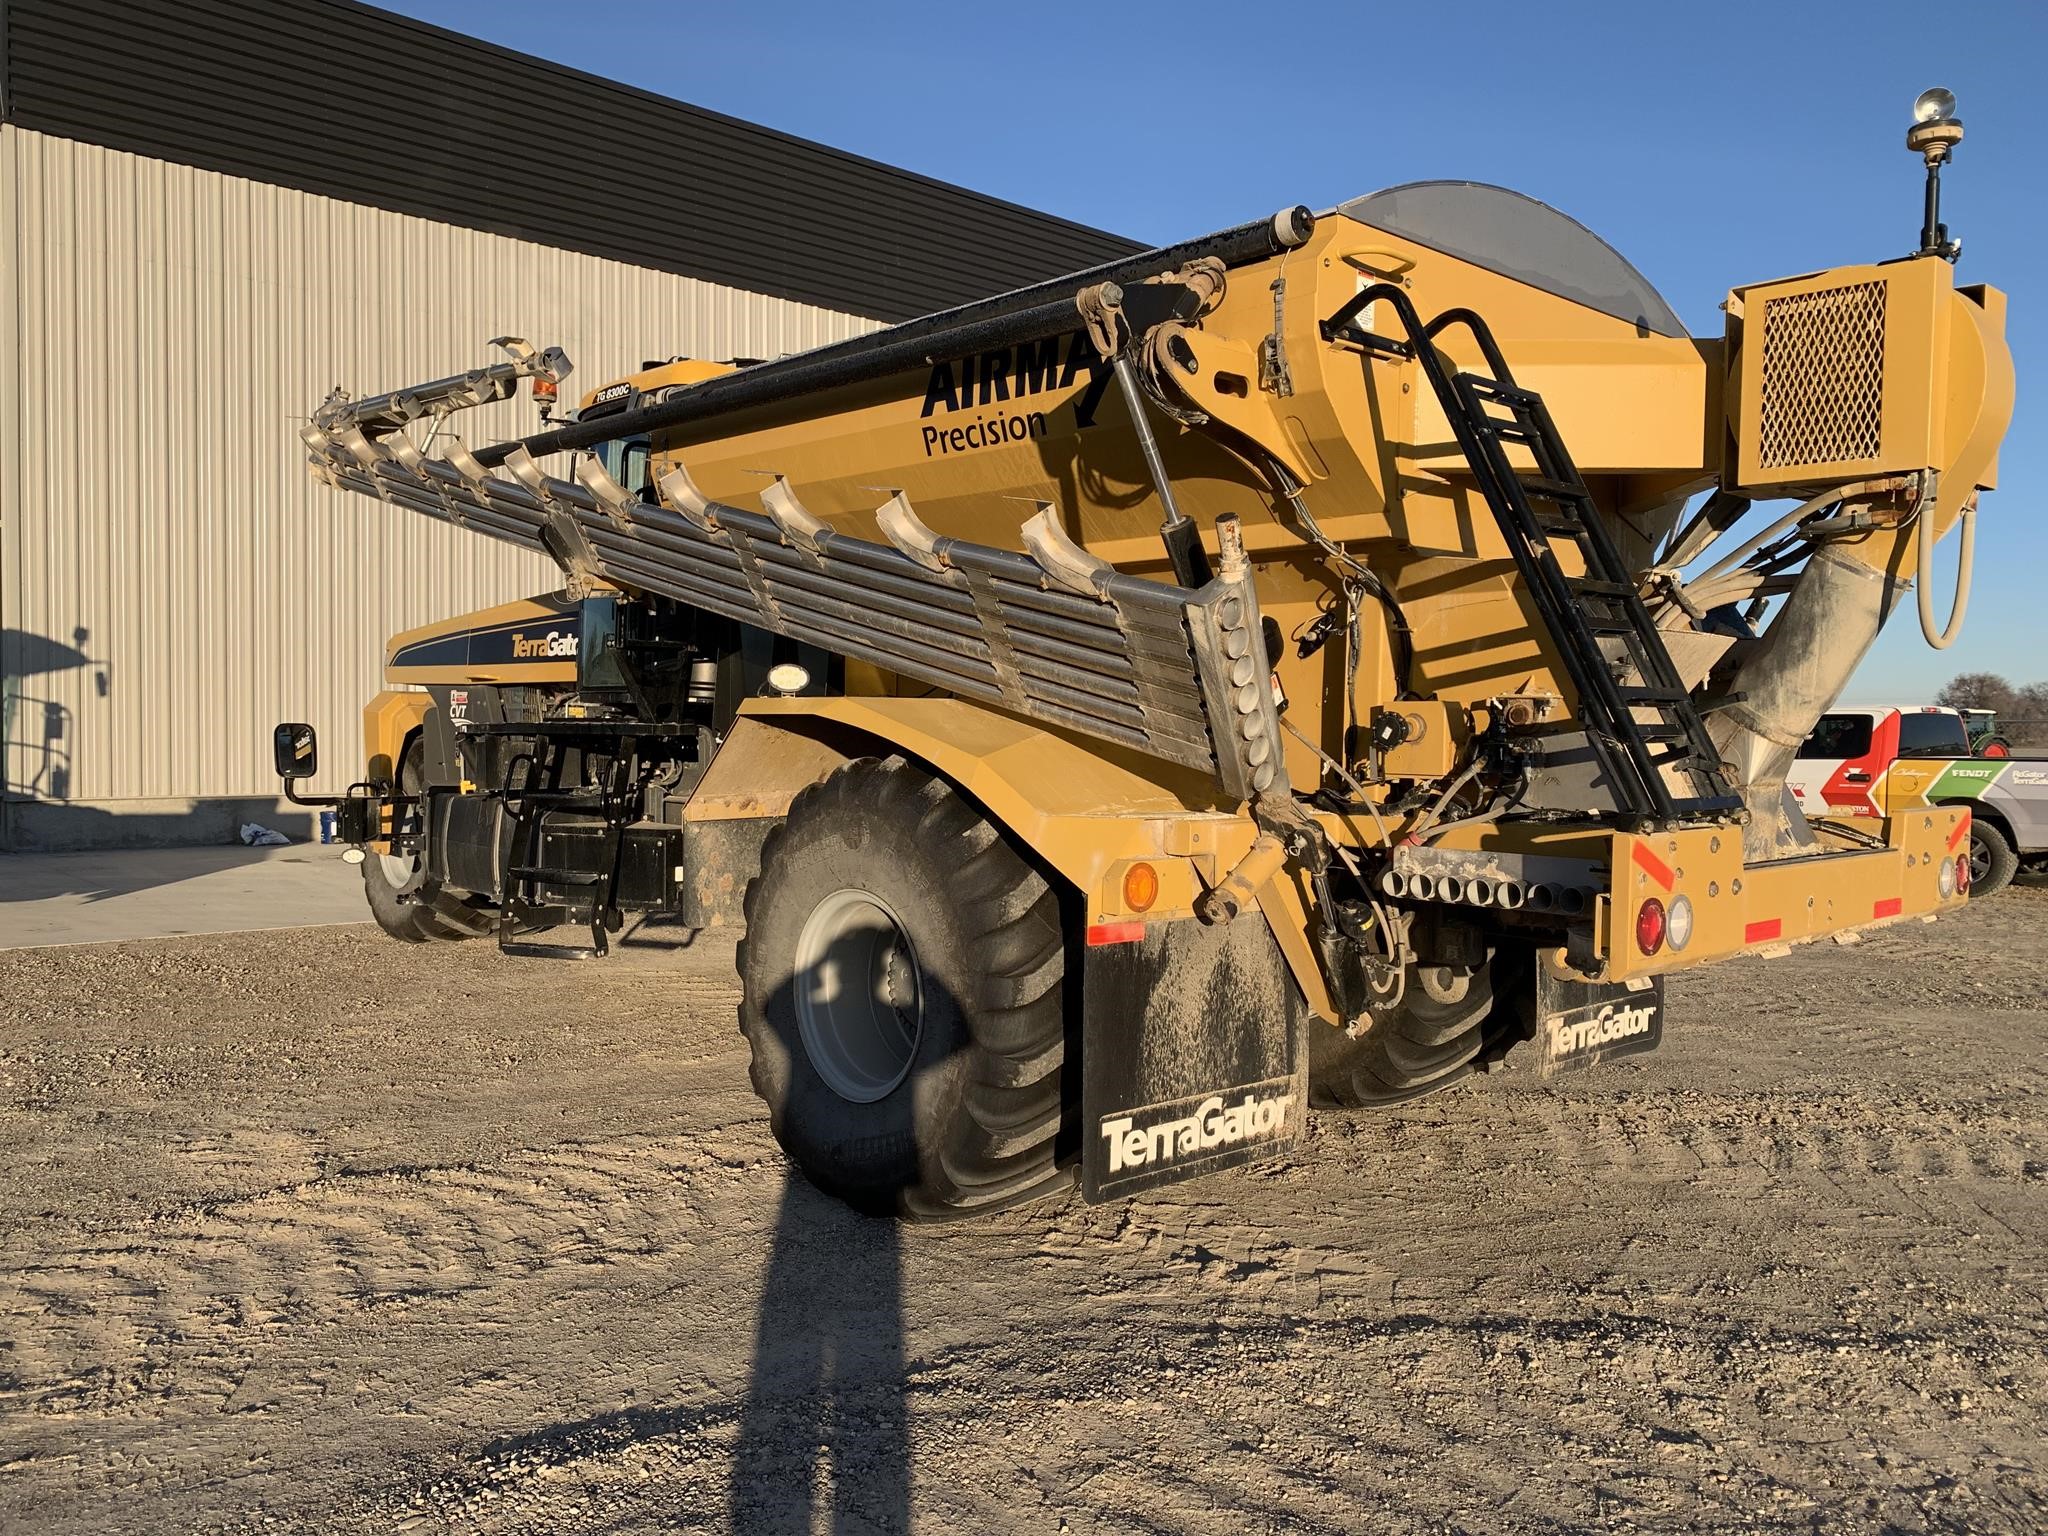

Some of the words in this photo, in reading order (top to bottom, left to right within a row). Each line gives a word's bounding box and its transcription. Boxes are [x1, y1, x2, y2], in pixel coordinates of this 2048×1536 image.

[596, 390, 607, 403] TG
[606, 383, 630, 400] 8300C
[922, 411, 1048, 457] Precision
[450, 704, 467, 718] CVT
[1952, 769, 1993, 778] FENDT
[1546, 1005, 1656, 1056] TerraGator
[1101, 1094, 1297, 1172] TerraGator
